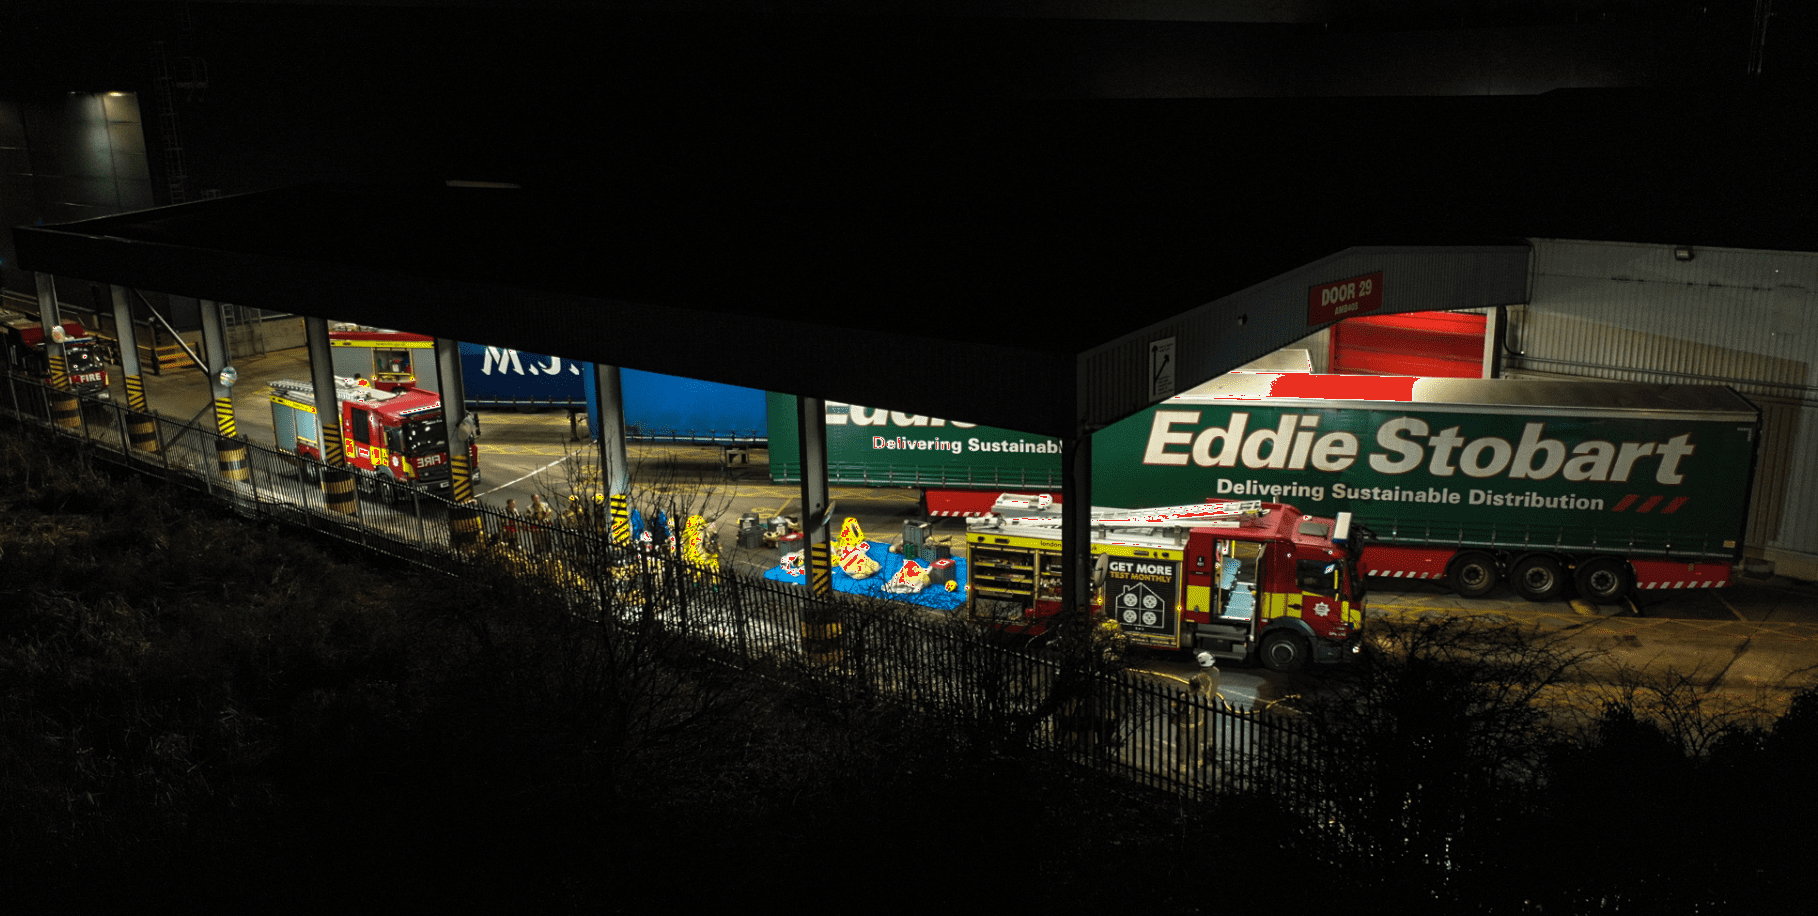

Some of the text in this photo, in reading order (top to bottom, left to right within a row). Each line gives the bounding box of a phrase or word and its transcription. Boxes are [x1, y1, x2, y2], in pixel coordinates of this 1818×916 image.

[1322, 279, 1372, 307] DOOR 29
[80, 372, 102, 383] FIRE
[872, 436, 962, 455] Delivering
[1142, 409, 1694, 485] Eddie Stobart
[1216, 478, 1605, 511] Delivering Sustainable Distribution
[1109, 561, 1173, 576] GET MORE
[1109, 571, 1172, 583] TEST MONTHLY
